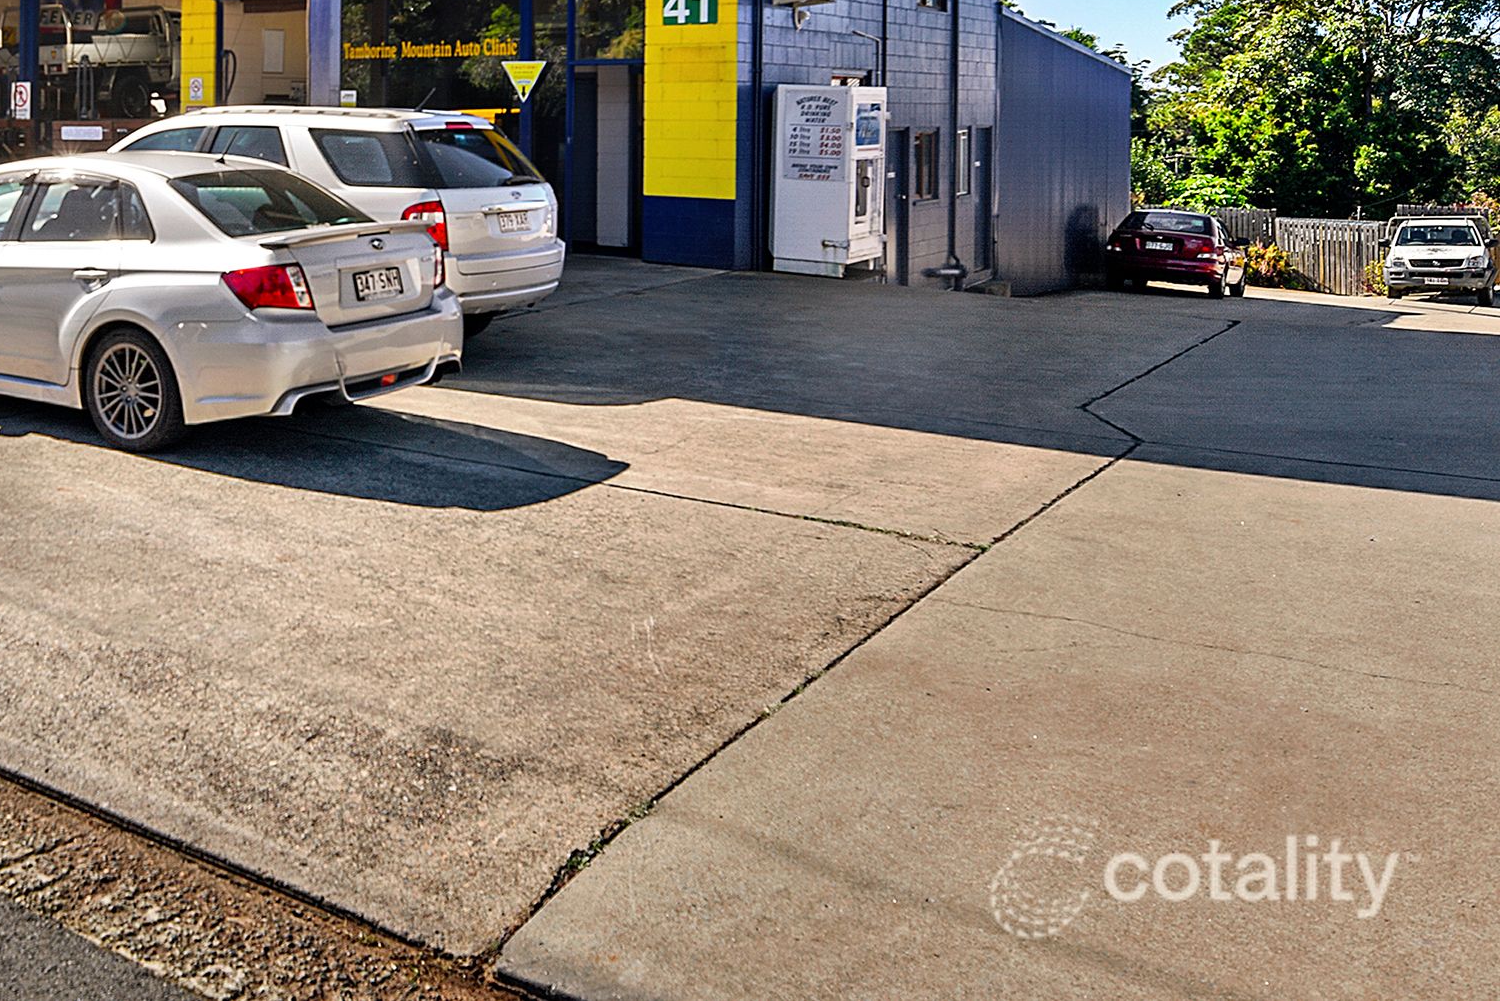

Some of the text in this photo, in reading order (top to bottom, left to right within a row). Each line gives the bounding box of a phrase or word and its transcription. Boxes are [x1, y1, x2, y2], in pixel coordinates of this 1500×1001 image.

[343, 37, 518, 60] Tamborine Mountain Auto Clinic
